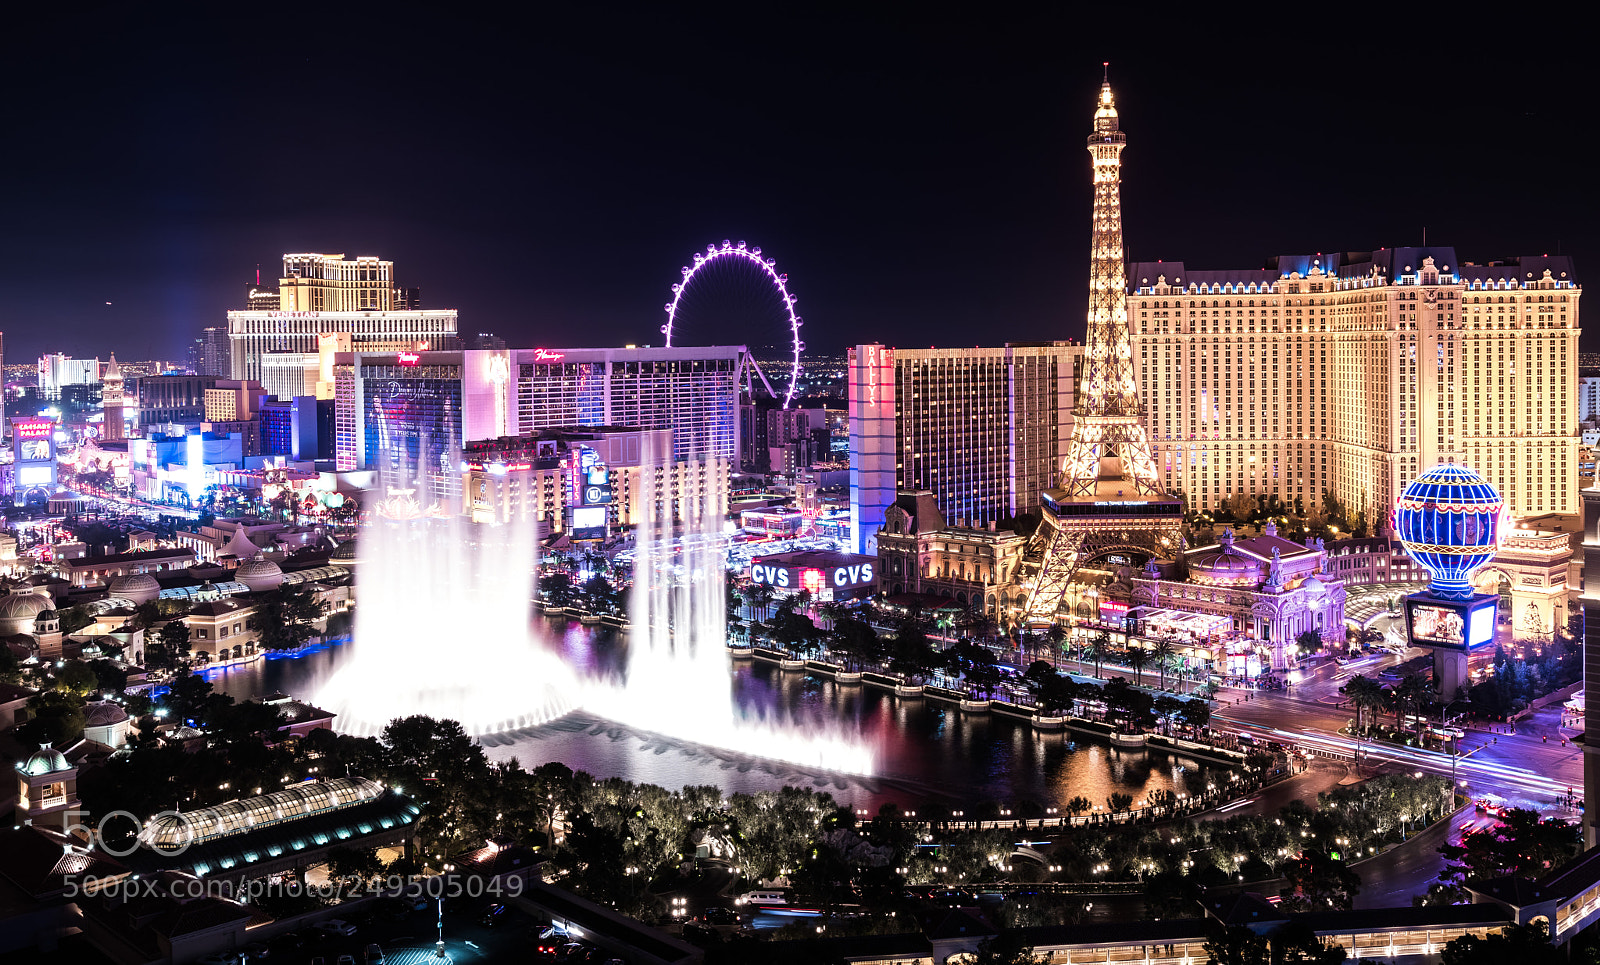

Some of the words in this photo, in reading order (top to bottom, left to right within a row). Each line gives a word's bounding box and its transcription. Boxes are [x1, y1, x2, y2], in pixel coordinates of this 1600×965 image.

[534, 349, 564, 361] Flamingo
[752, 565, 789, 587] CVS
[834, 563, 873, 587] CVS
